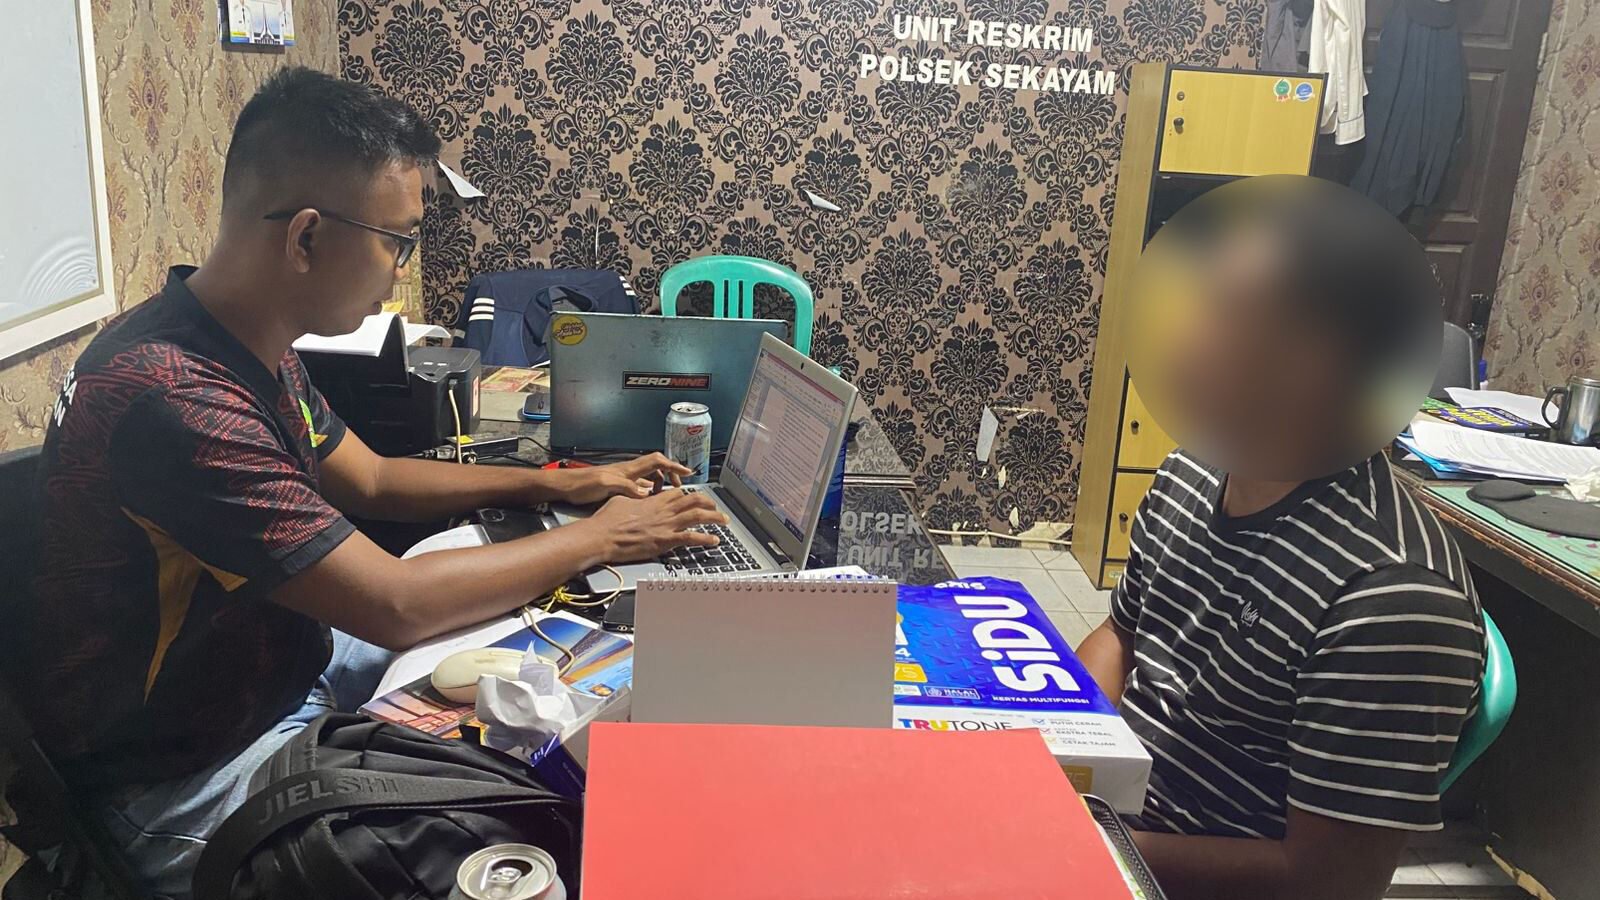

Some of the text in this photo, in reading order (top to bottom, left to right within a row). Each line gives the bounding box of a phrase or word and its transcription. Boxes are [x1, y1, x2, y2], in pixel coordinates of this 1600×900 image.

[893, 14, 1093, 52] UNIT RESKRIM
[860, 54, 1115, 95] POLSEK SEKAYAM
[626, 376, 706, 387] ZERONINE
